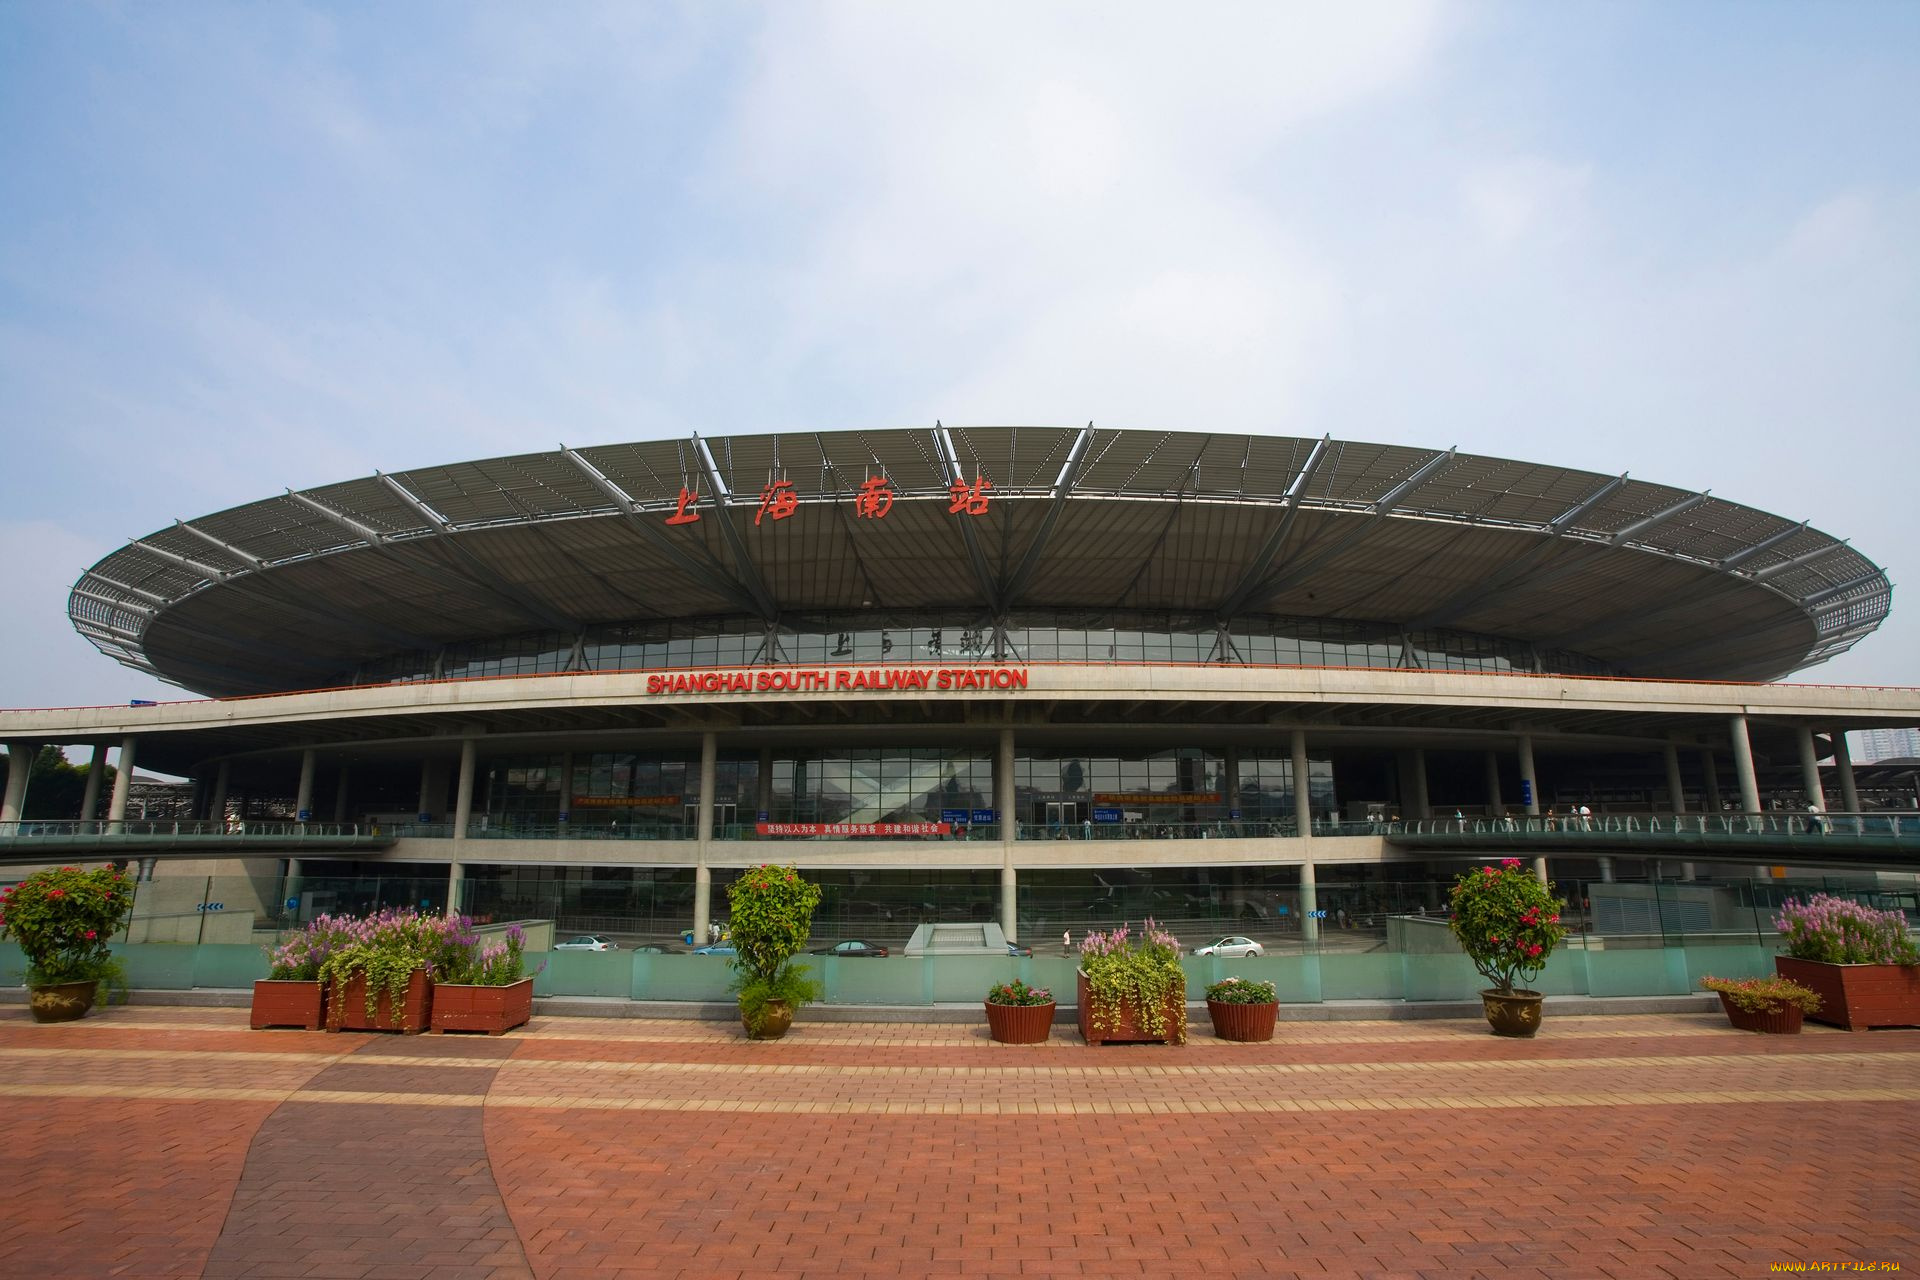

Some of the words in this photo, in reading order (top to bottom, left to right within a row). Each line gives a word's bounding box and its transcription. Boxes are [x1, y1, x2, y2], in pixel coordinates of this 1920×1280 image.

[665, 475, 992, 526] 上海南站
[647, 672, 753, 694] SHANGHAI
[756, 671, 829, 691] SOUTH
[836, 670, 934, 690] RAILWAY
[936, 669, 1028, 689] STATION
[767, 824, 817, 834] 坚持以人为本
[884, 823, 939, 834] 共建和谐社会
